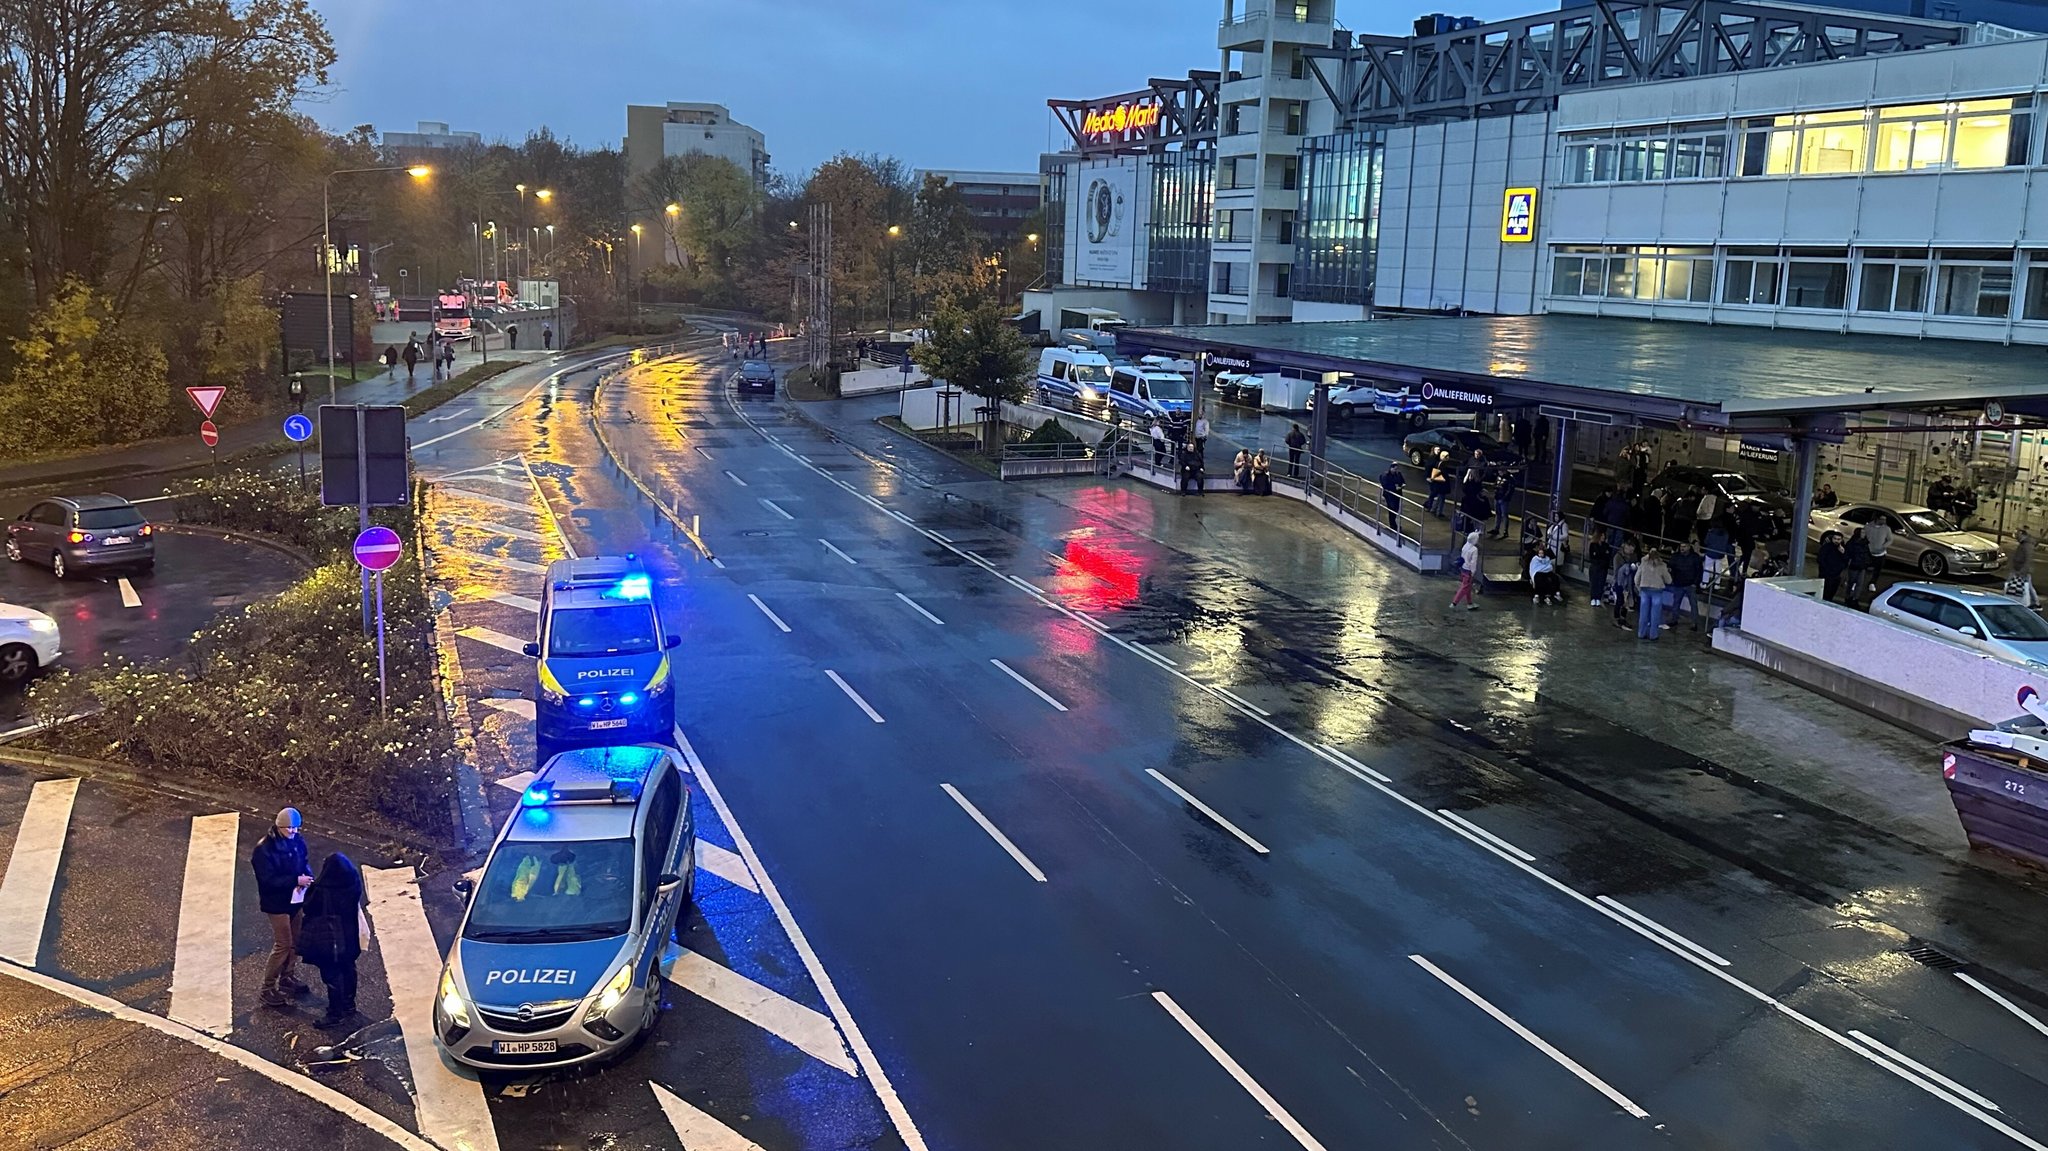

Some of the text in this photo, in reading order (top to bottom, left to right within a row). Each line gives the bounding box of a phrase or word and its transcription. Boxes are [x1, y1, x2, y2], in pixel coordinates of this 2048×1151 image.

[1082, 103, 1158, 135] Media Markt
[1508, 217, 1527, 228] ALDI
[1213, 356, 1250, 368] ANLIEFERUNG 5
[1433, 388, 1493, 405] ANLIEFERUNG 5
[577, 668, 635, 680] POLIZEI
[2004, 780, 2025, 795] 272
[485, 969, 577, 985] POLIZEI
[499, 1042, 555, 1053] WI HP 5828
